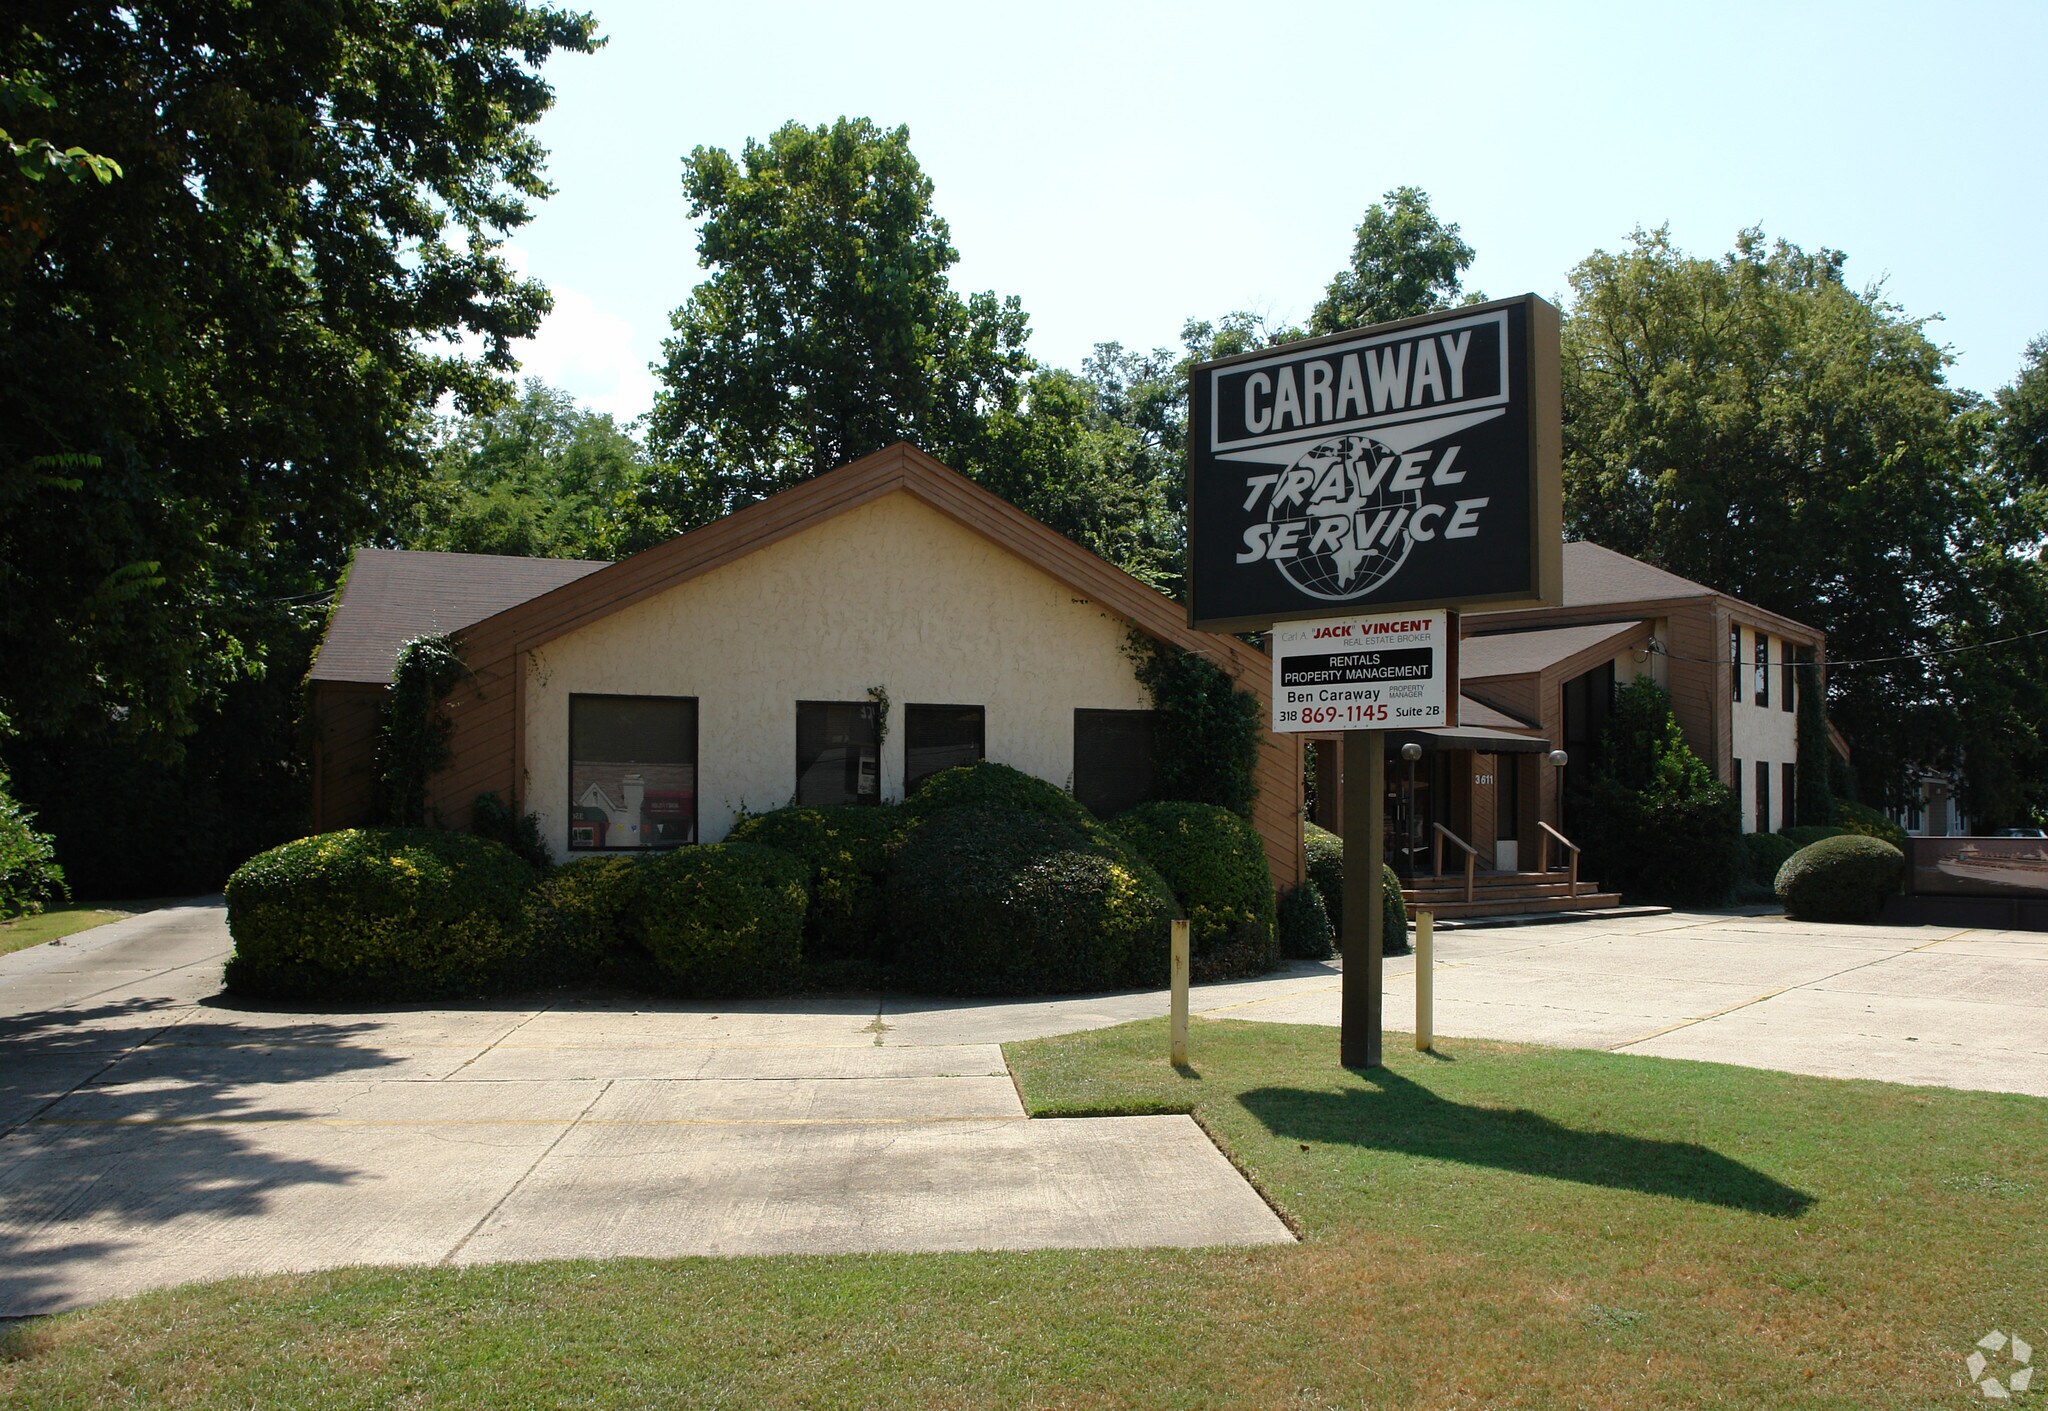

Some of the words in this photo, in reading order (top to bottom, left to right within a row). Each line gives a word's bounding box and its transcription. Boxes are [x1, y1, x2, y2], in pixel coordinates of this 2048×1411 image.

[1244, 330, 1472, 434] CARAWAY
[1242, 445, 1467, 512] TRAVEL
[1236, 497, 1490, 564] SERVICE
[1281, 632, 1298, 642] Carl
[1361, 619, 1432, 635] VINCENT
[1343, 638, 1363, 647] REAL
[1365, 635, 1395, 645] ESTATE
[1397, 633, 1431, 643] BROKER
[1329, 654, 1381, 667] RENTALS
[1284, 669, 1342, 684] PROPERTY
[1346, 664, 1429, 680] MANAGEMENT
[1287, 691, 1313, 703] Ben
[1319, 689, 1381, 702] Caraway
[1389, 684, 1425, 692] PROPERTY
[1389, 691, 1423, 699] MANAGER
[1279, 711, 1298, 722] 318
[1301, 704, 1388, 724] 869-1145
[1396, 707, 1423, 717] Suite
[1425, 705, 1440, 716] 2B
[1475, 774, 1493, 785] 3611
